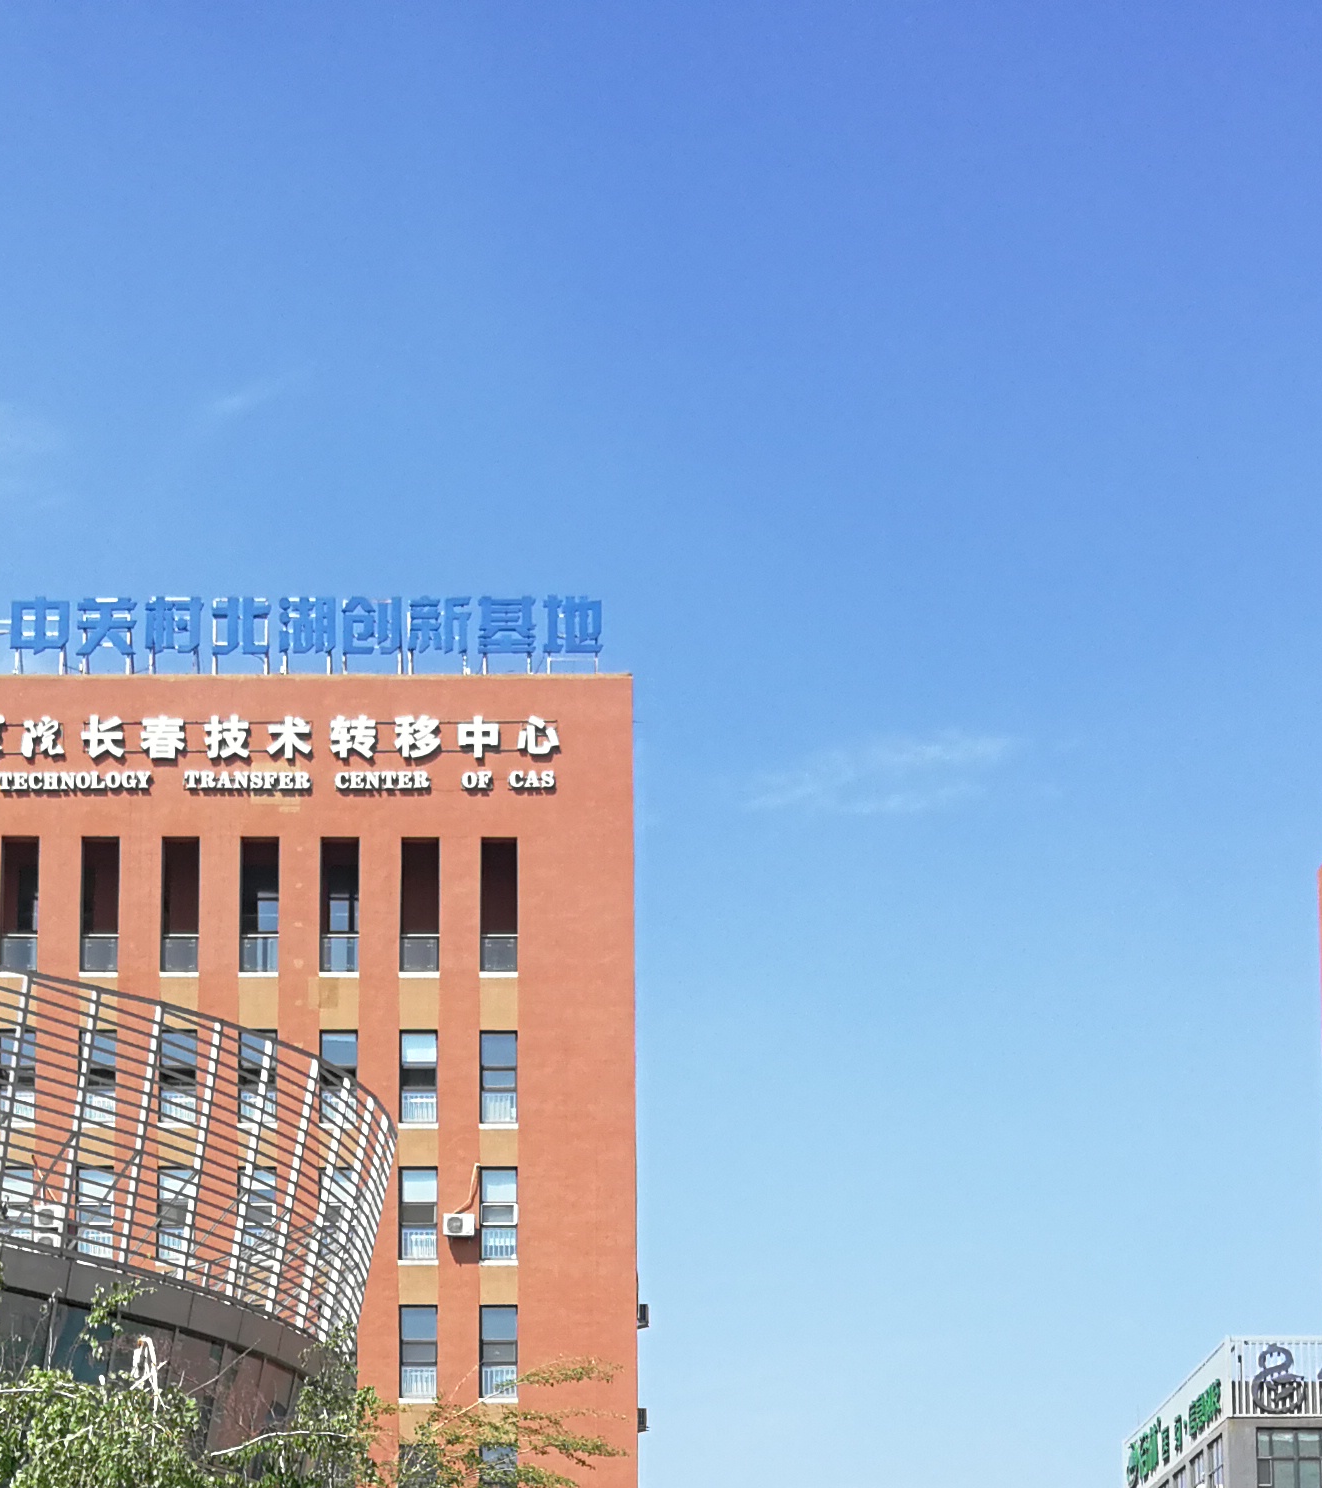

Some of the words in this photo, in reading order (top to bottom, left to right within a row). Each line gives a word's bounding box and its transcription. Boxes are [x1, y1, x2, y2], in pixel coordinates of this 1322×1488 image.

[183, 770, 312, 790] TRANSFER
[333, 770, 431, 790] CENTER
[460, 770, 494, 790] OF
[507, 770, 557, 789] CAS
